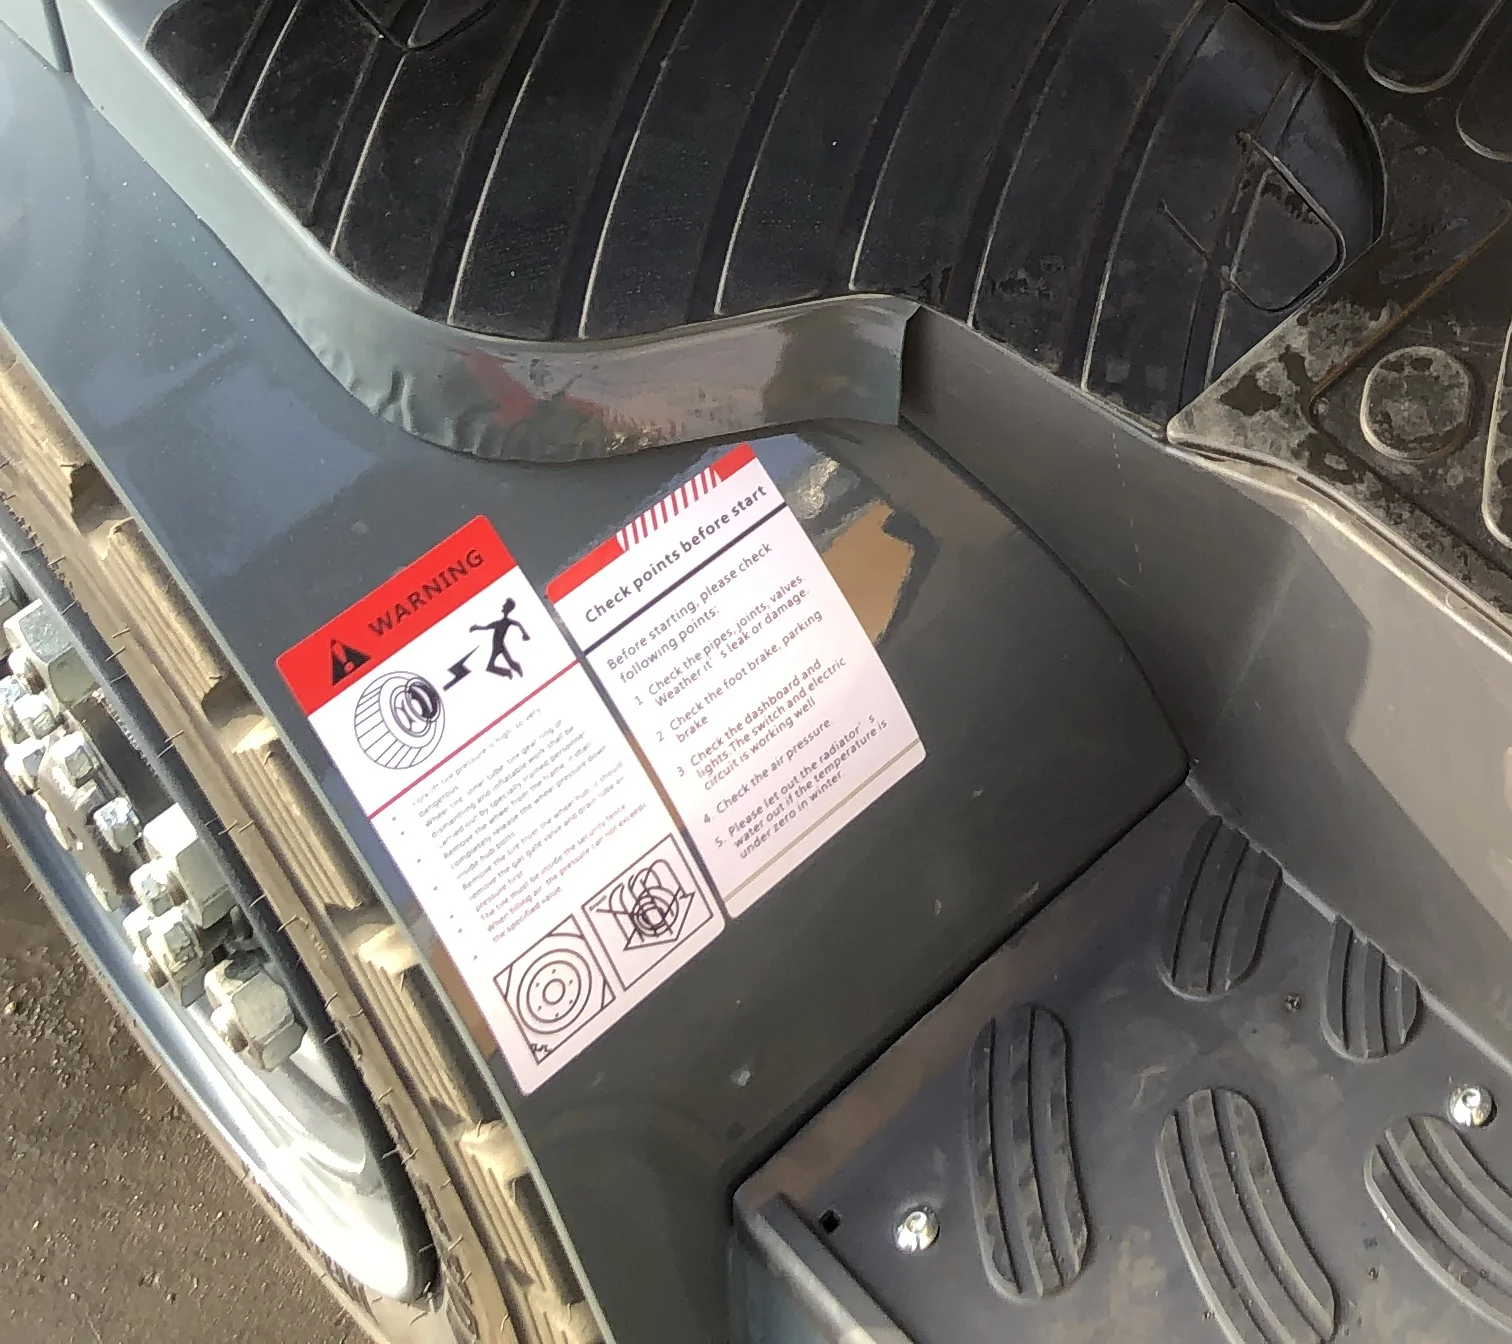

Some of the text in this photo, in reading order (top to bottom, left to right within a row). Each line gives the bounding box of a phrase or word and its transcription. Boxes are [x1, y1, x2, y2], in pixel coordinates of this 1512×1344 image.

[366, 546, 485, 639] WARNING
[586, 486, 766, 622] Check points before start
[607, 544, 772, 670] Before starting, please check
[620, 606, 719, 683] following points:
[649, 667, 683, 695] Check
[683, 653, 702, 669] the
[655, 669, 700, 706] Weather
[726, 632, 750, 652] leak
[752, 622, 762, 634] or
[670, 703, 704, 730] Check
[704, 687, 723, 704] the
[723, 668, 748, 689] foot
[782, 611, 822, 647] parking
[752, 706, 785, 736] switch
[787, 687, 807, 708] and
[808, 658, 846, 691] electric
[676, 716, 708, 743] brake
[691, 737, 724, 766] Check
[724, 723, 743, 739] the
[745, 675, 800, 724] dashboard
[802, 658, 821, 680] and
[705, 696, 815, 790] circuit is working well
[717, 784, 750, 813] Check
[750, 769, 768, 786] the
[771, 756, 784, 771] air
[728, 806, 763, 837] Please
[764, 792, 779, 808] let
[781, 776, 799, 794] out
[800, 762, 817, 779] the
[734, 720, 887, 848] water out if the temperature is
[740, 800, 808, 859] under zero in
